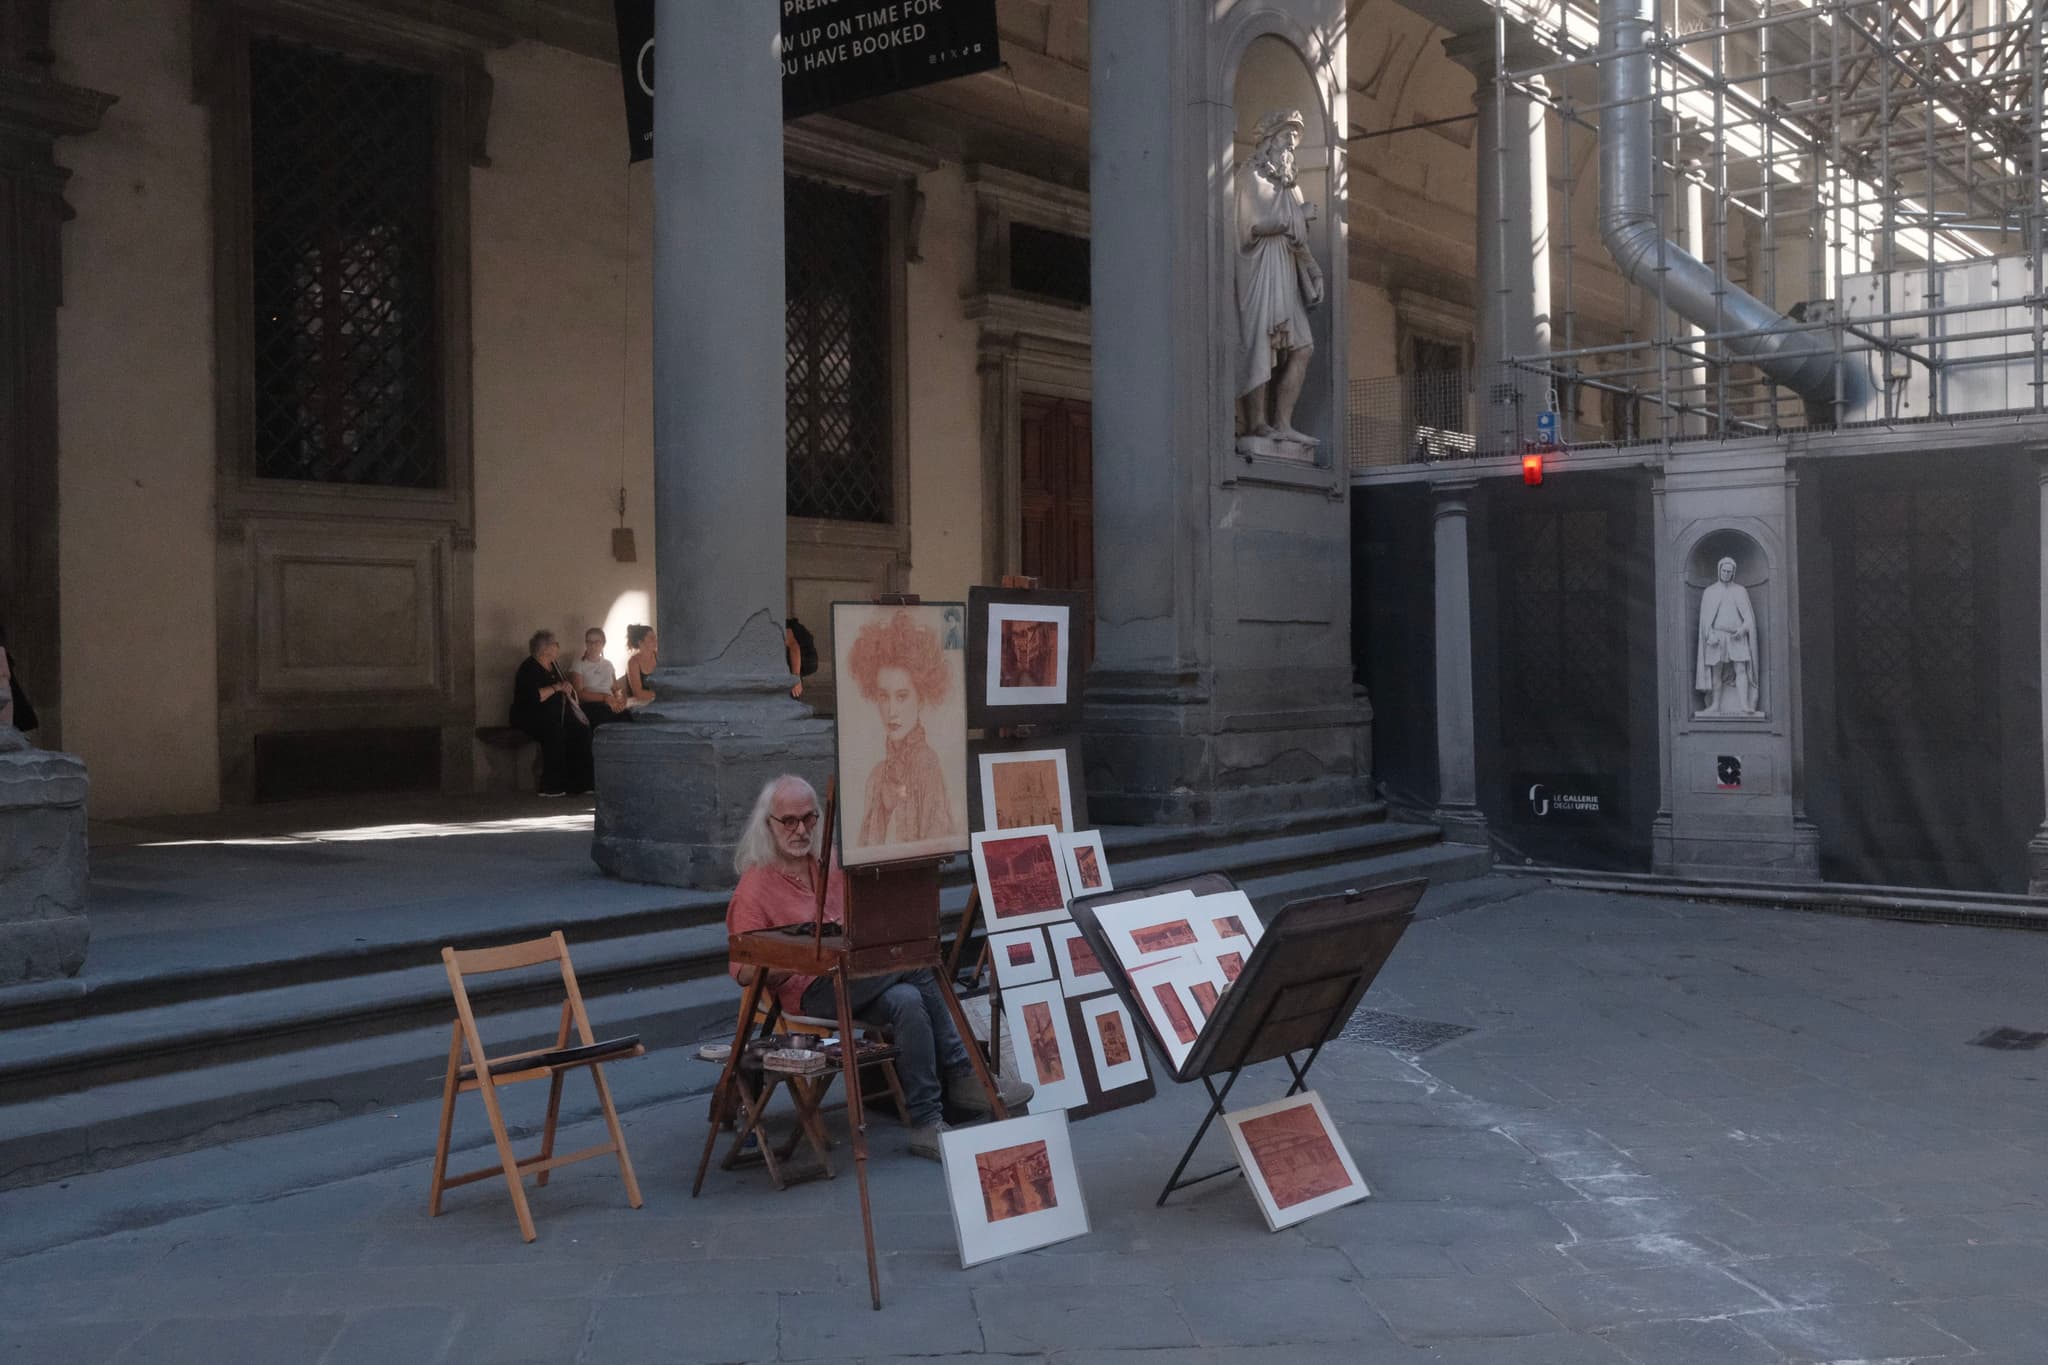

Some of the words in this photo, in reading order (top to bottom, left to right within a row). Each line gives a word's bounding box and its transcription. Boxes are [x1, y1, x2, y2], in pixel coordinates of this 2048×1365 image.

[800, 27, 822, 47] UP
[826, 18, 852, 39] ON
[855, 5, 899, 31] TIME
[903, 0, 942, 19] FOR
[804, 44, 848, 71] HAVE
[852, 23, 926, 57] BOOKED
[1553, 802, 1574, 810] DEGLI
[1575, 803, 1600, 811] UFFIZI
[1562, 794, 1599, 803] GALLERIE
